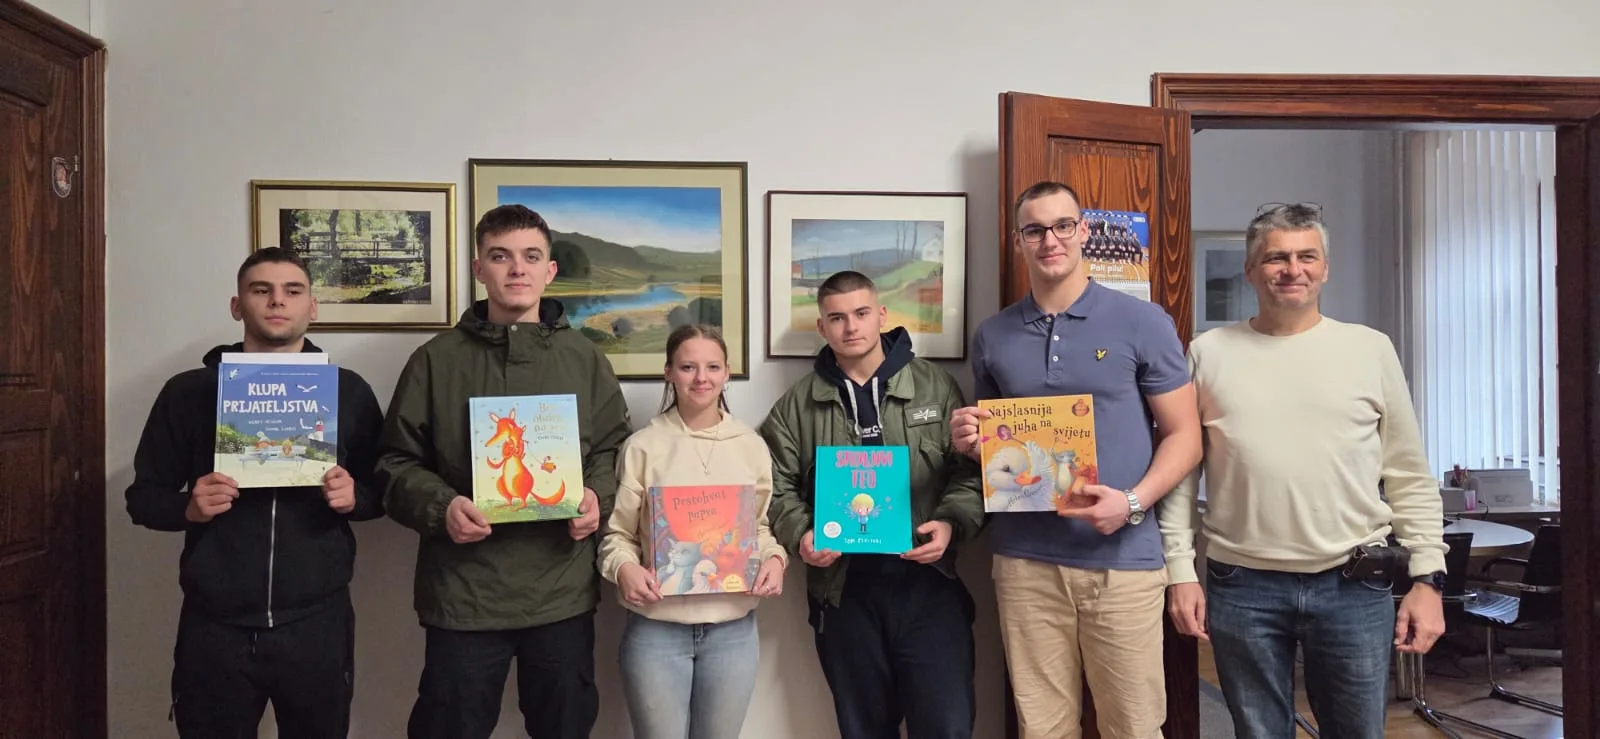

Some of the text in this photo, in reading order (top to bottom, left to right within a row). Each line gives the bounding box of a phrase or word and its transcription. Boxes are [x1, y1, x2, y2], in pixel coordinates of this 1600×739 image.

[248, 383, 287, 396] KLUPA
[223, 400, 318, 414] PRIJATELJSTVA
[988, 403, 1052, 420] Najslasnija
[1013, 419, 1091, 439] juha na svijetu
